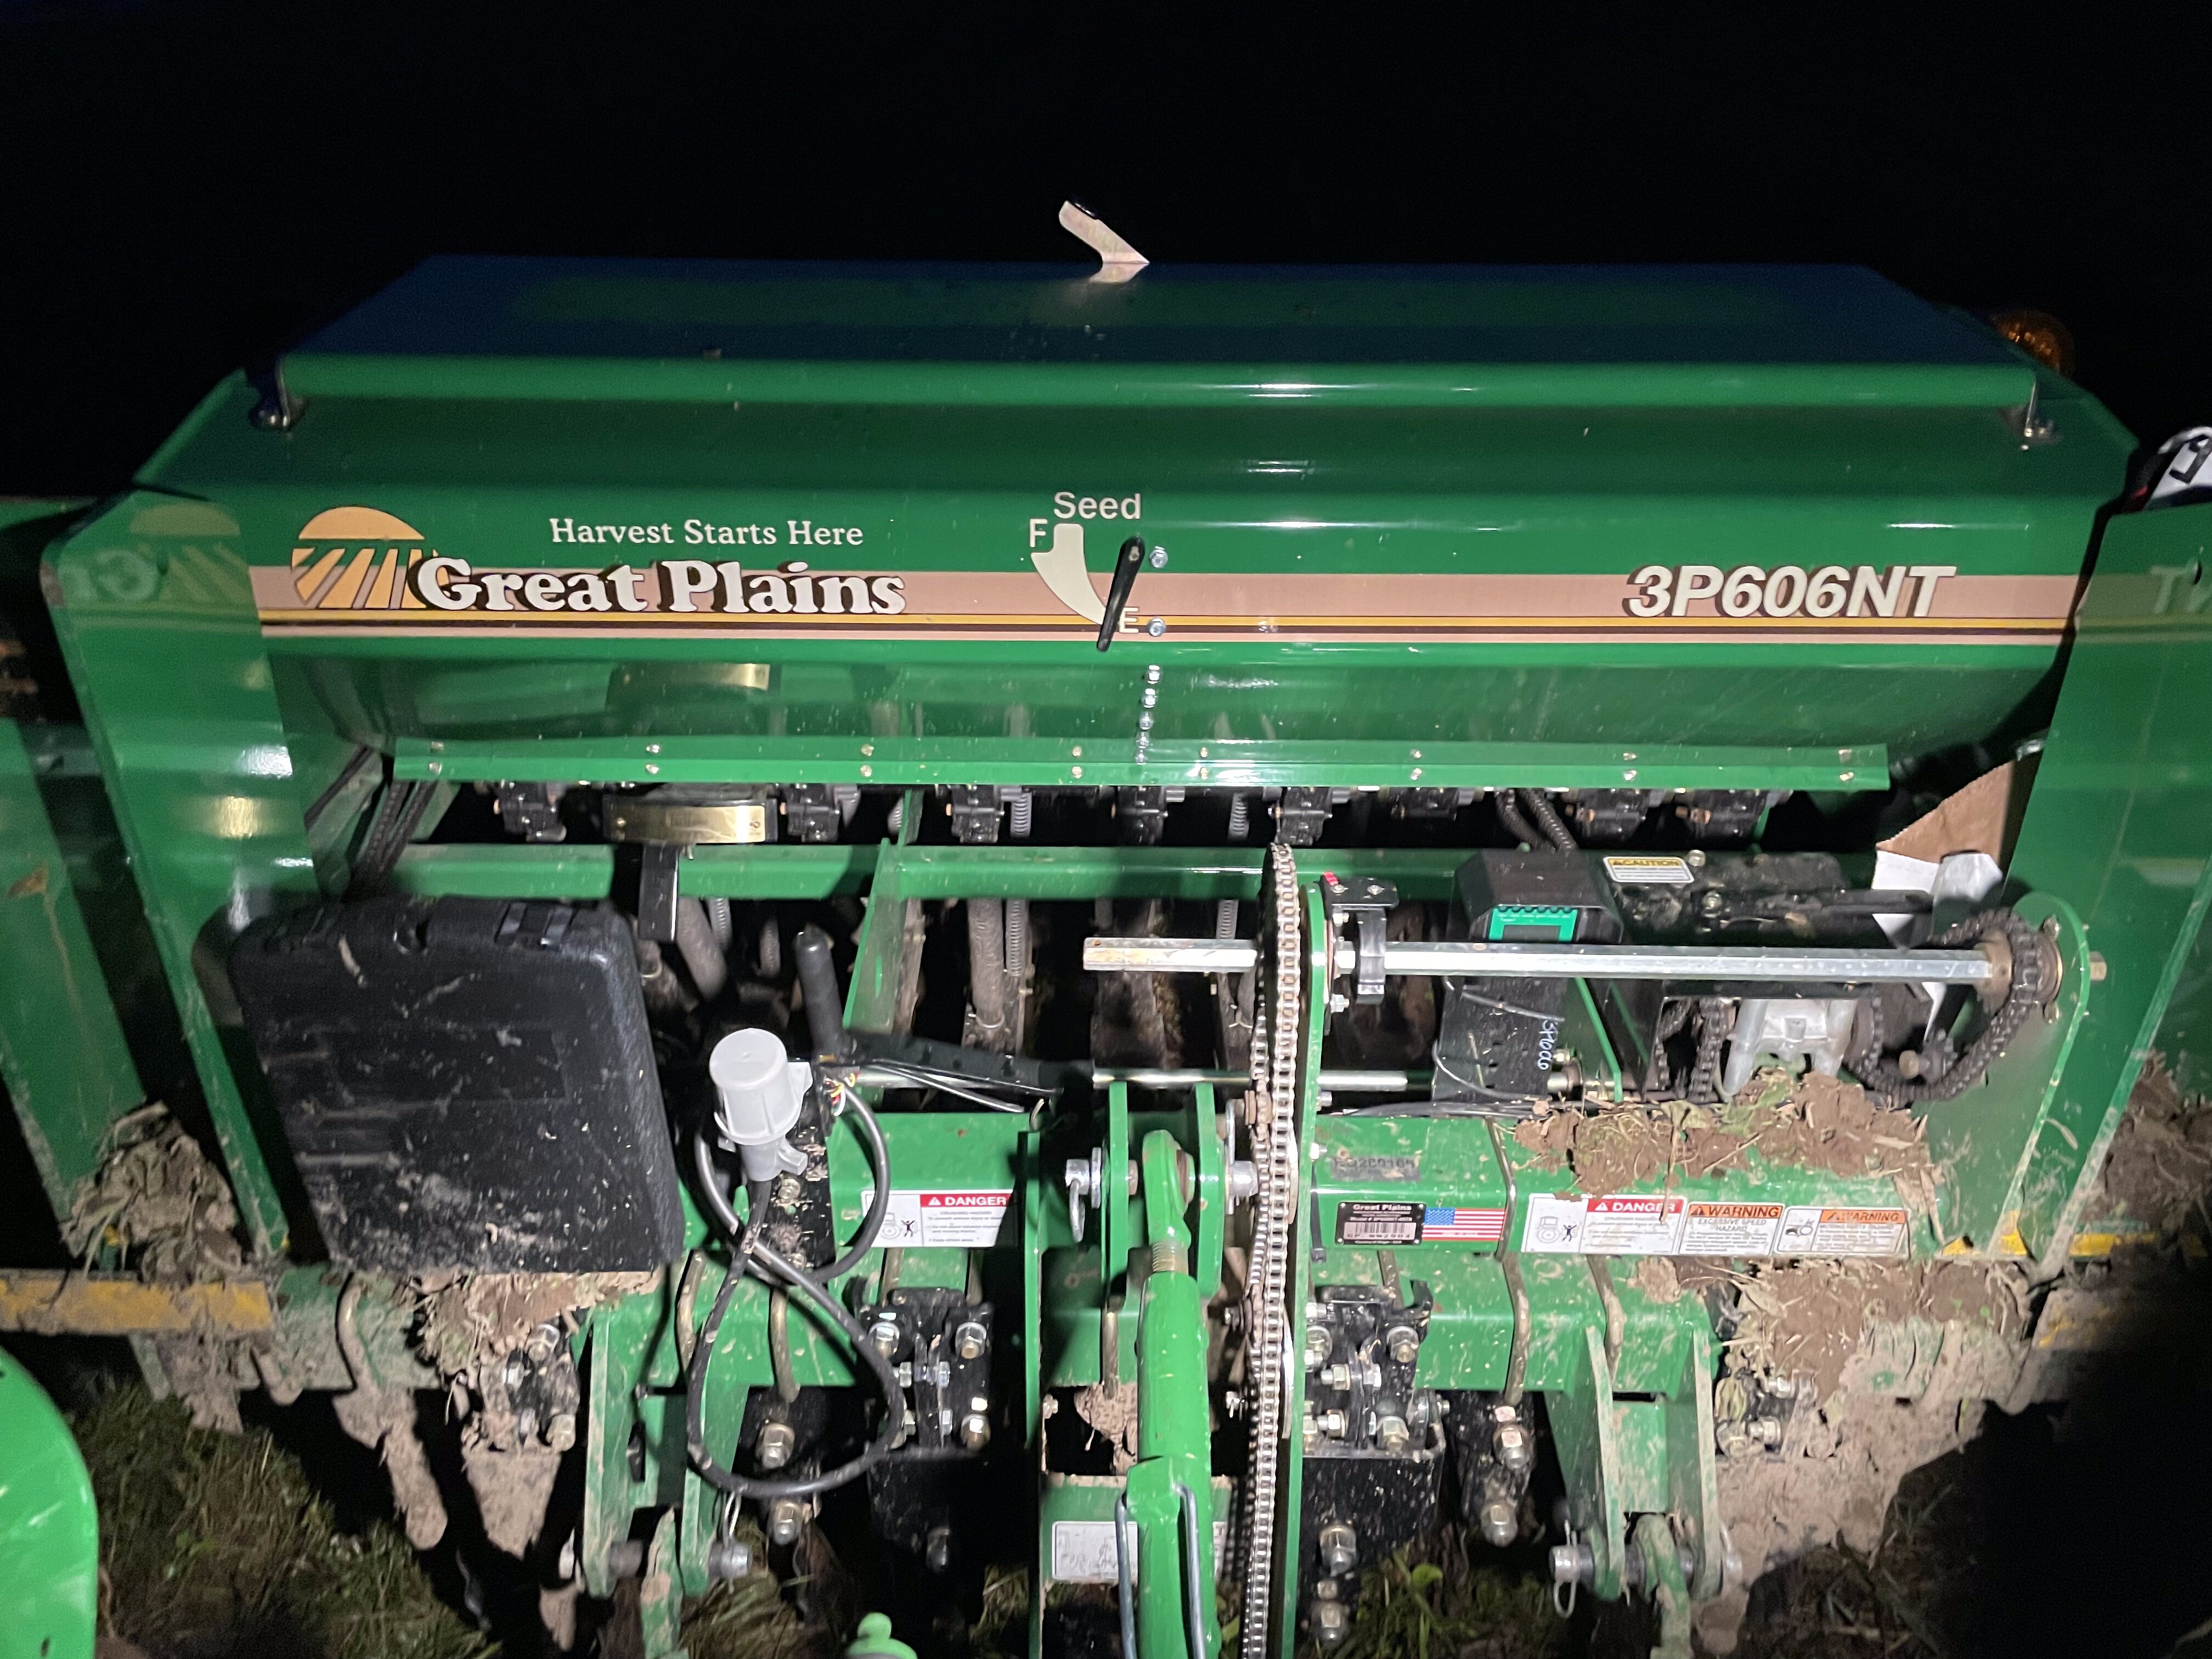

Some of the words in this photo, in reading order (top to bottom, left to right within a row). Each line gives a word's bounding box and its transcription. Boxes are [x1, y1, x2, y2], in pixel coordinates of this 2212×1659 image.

[1053, 492, 1141, 519] Seed
[550, 518, 673, 545] Harvest
[685, 520, 777, 545] Starts
[788, 521, 863, 546] Here
[1029, 518, 1048, 548] F
[411, 557, 648, 612] Great
[659, 560, 906, 614] Plains
[1625, 565, 1957, 618] 3P606NT
[1119, 607, 1139, 633] E
[945, 1197, 1007, 1206] DANGER
[1708, 1205, 1779, 1217] WARNING
